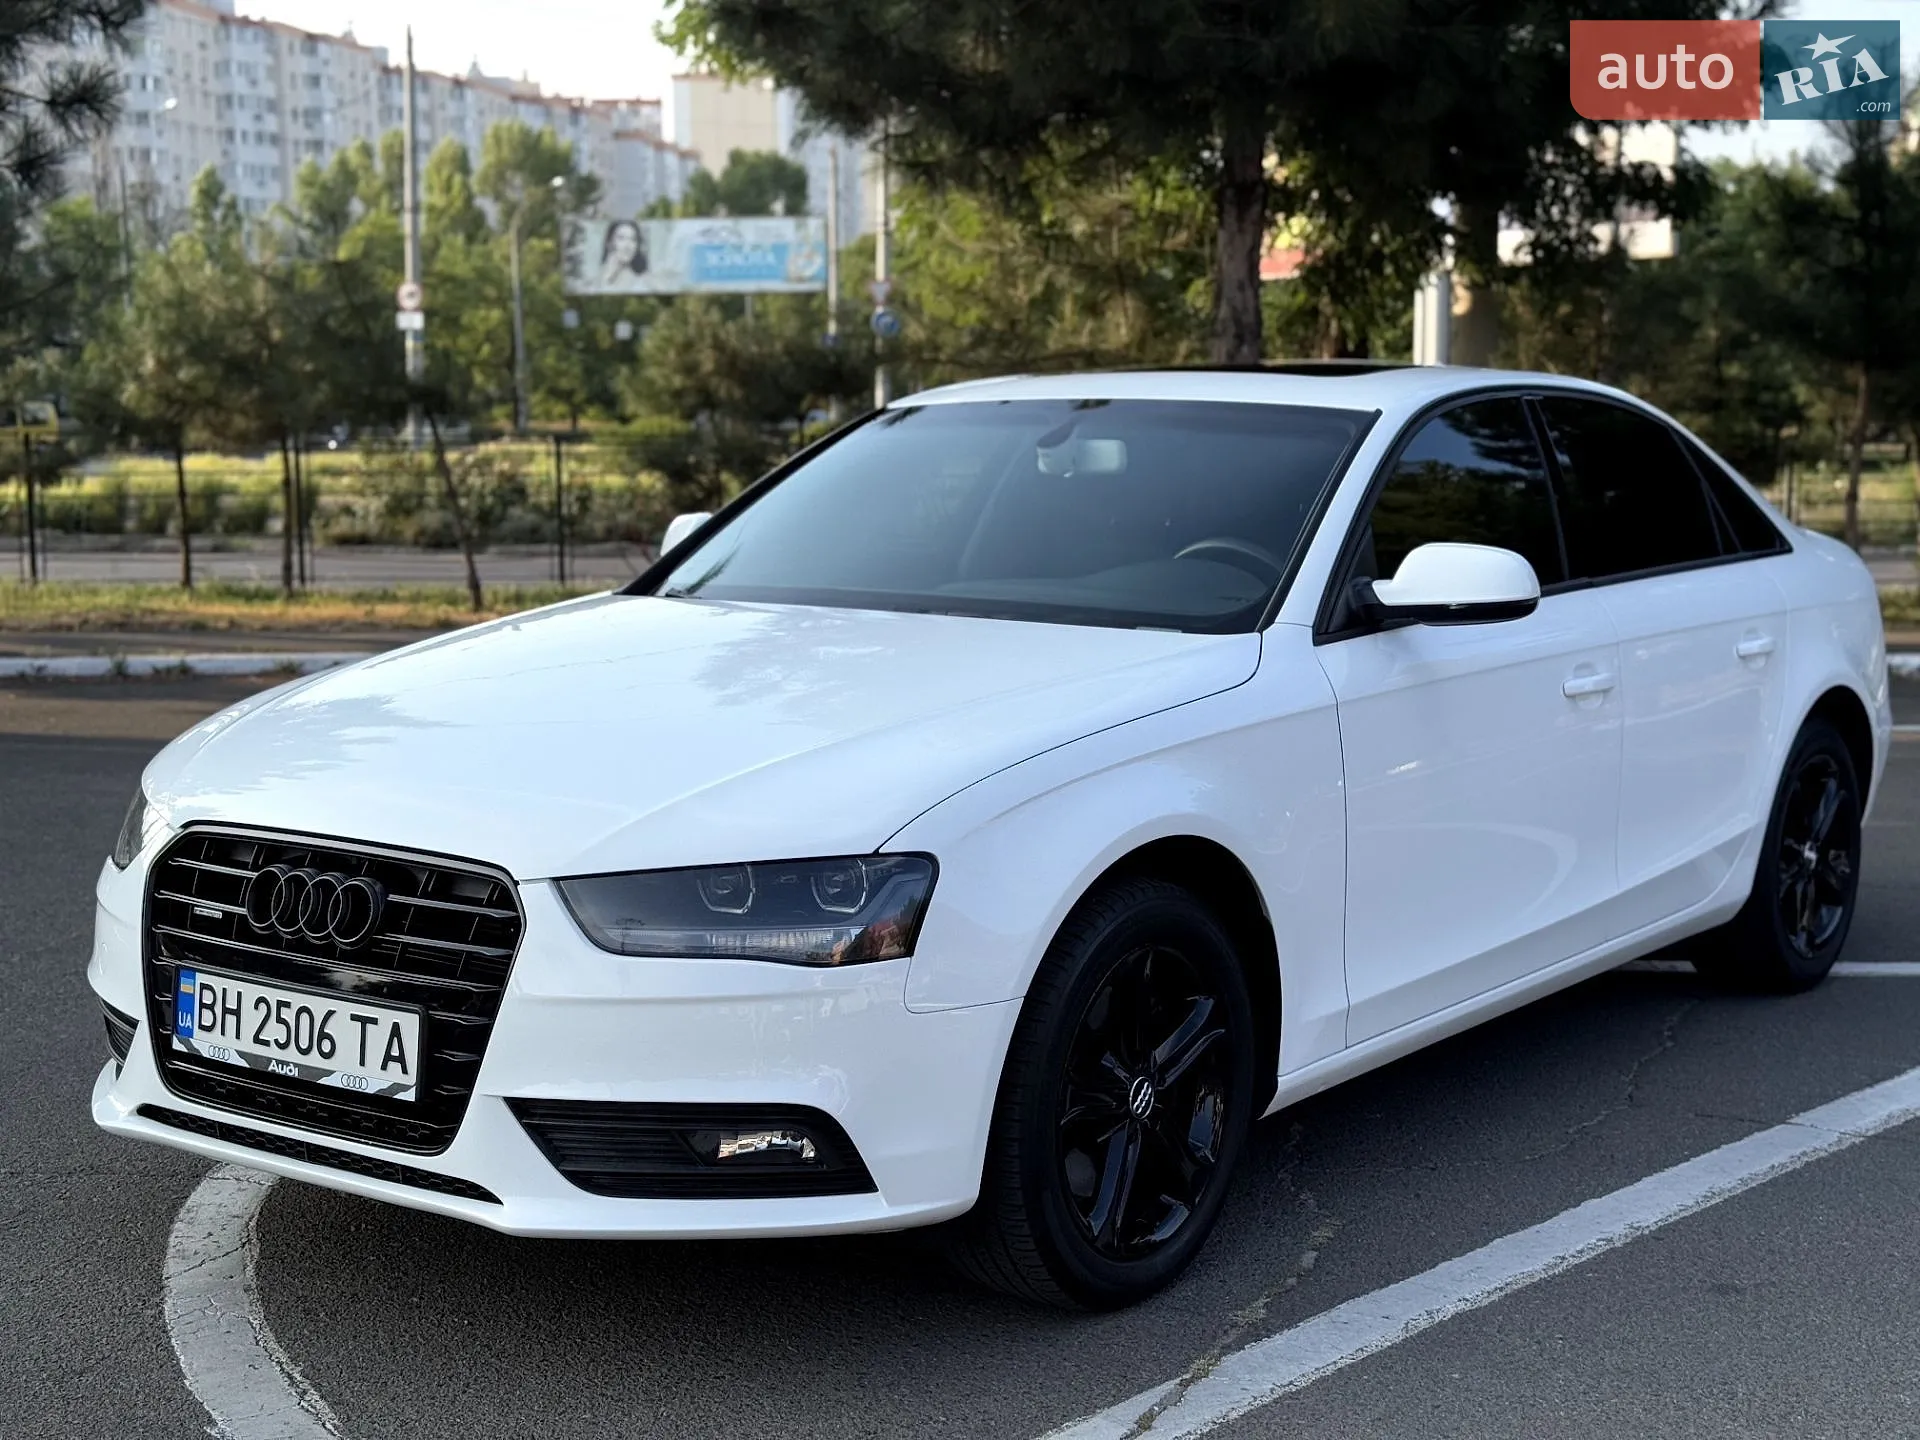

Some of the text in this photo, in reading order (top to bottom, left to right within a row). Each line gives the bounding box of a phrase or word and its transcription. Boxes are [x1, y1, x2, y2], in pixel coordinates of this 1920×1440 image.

[178, 1010, 193, 1030] UA
[198, 982, 409, 1075] BH 2506 TA
[267, 1059, 299, 1078] Audi
